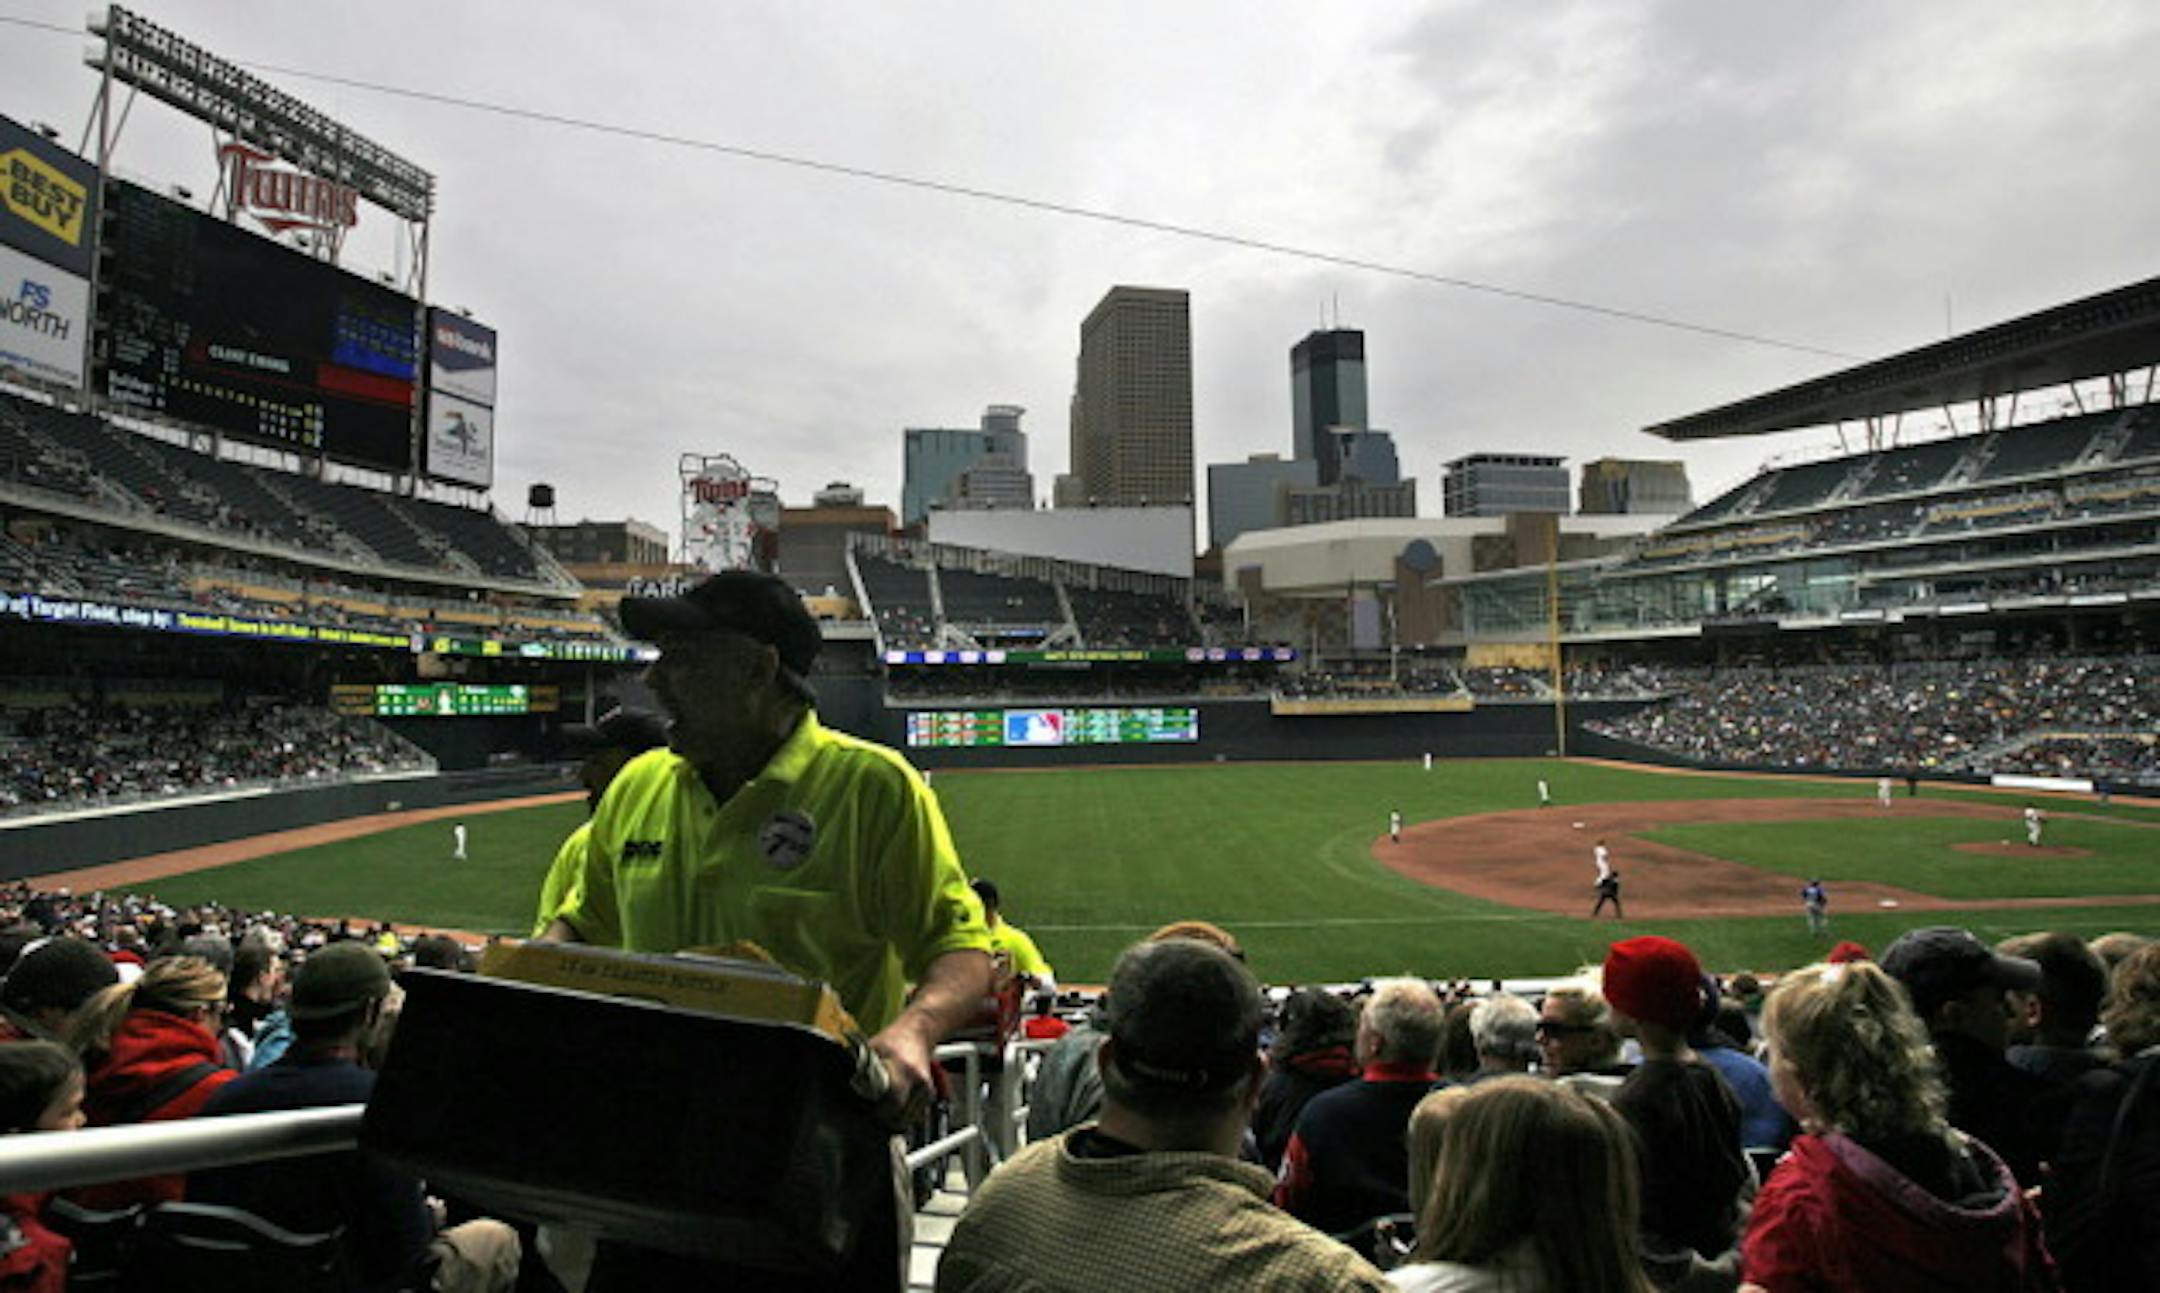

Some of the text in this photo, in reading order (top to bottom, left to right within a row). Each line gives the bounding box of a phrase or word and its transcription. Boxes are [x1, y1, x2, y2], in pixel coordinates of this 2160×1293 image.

[10, 157, 84, 213] BEST
[10, 182, 73, 231] BUY
[221, 143, 358, 228] Twins
[20, 280, 50, 309] FS
[32, 594, 80, 620] Target
